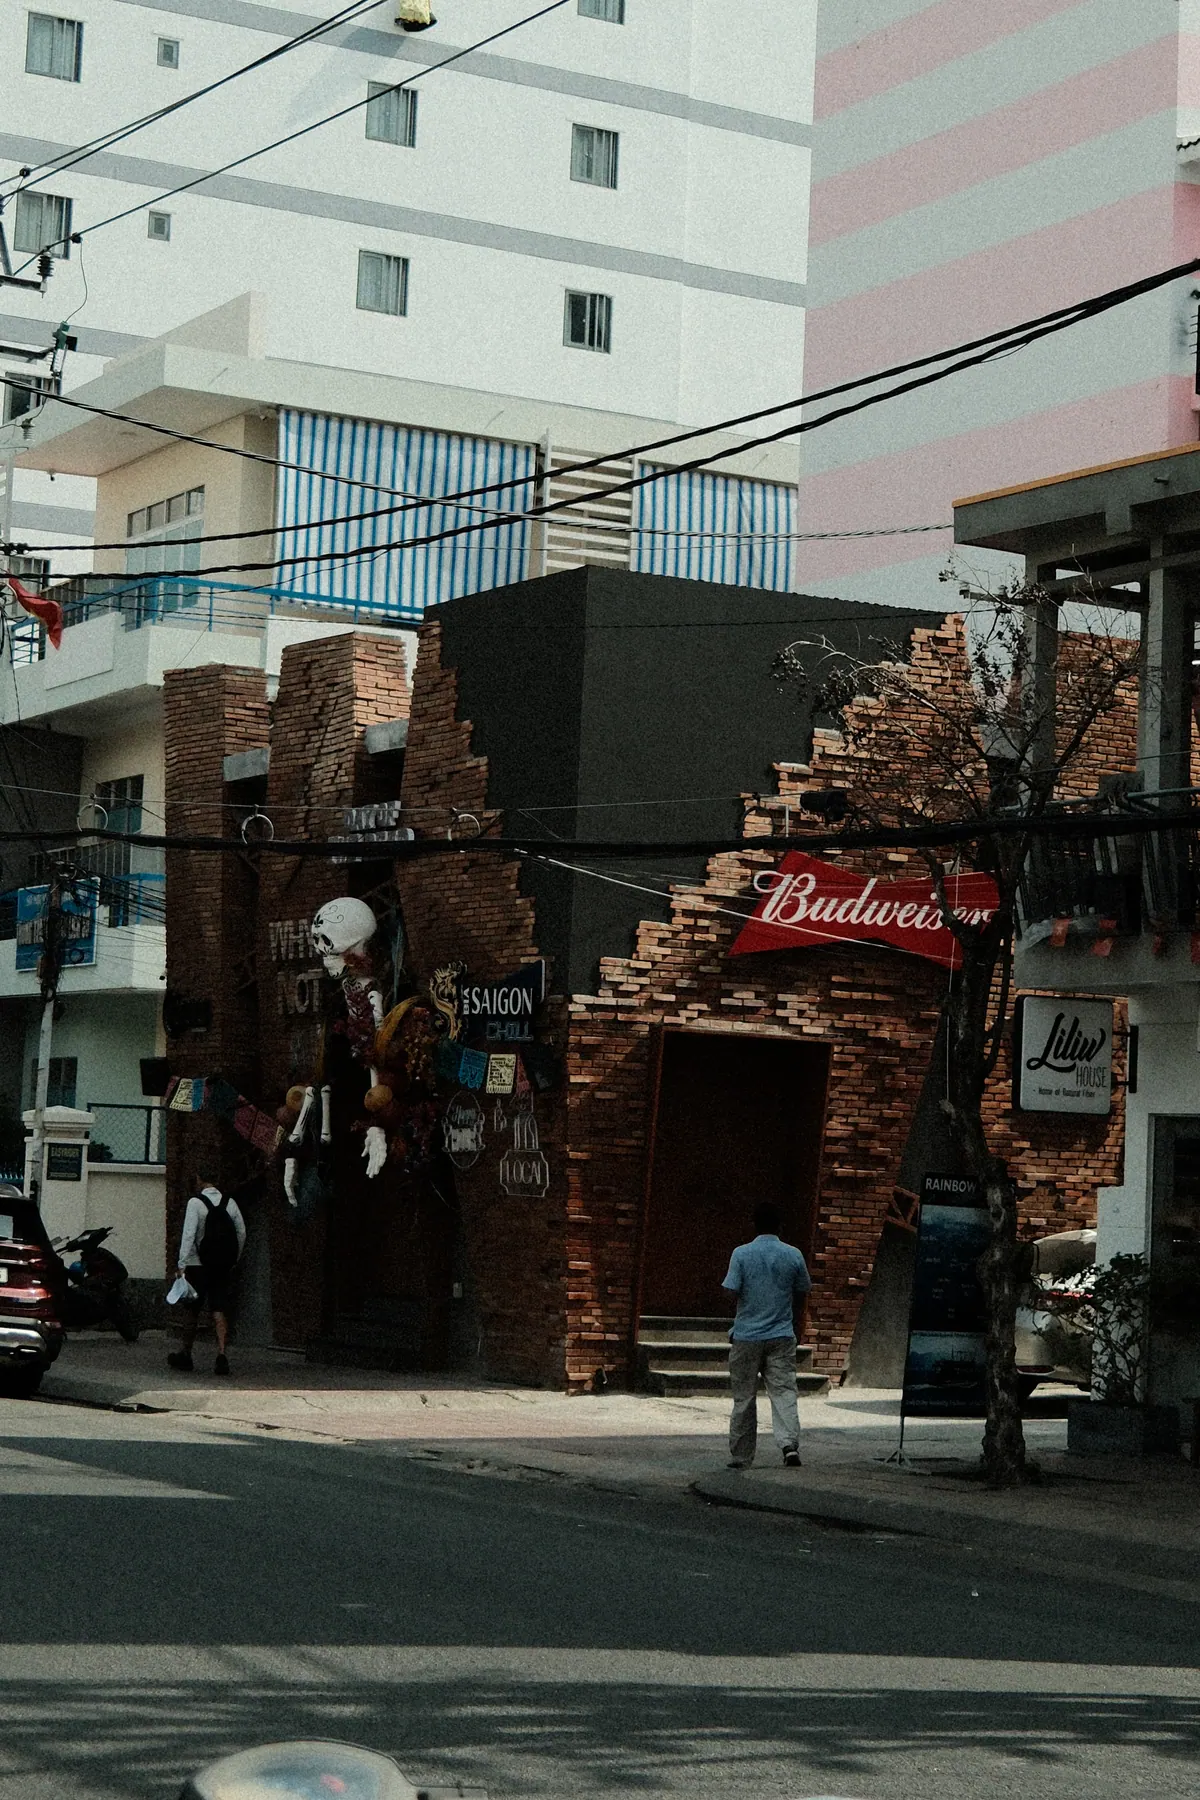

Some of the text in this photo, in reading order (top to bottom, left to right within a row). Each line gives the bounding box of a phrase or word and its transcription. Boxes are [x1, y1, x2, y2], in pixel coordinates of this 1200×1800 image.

[753, 870, 992, 932] Budweiser
[277, 968, 323, 1015] NOT
[462, 987, 470, 1015] BIA
[471, 986, 533, 1015] SAIGON
[486, 1020, 534, 1041] CHILL
[1026, 1012, 1107, 1073] Liliw
[1075, 1065, 1107, 1088] HOUSE
[924, 1177, 977, 1193] RAINBOW
